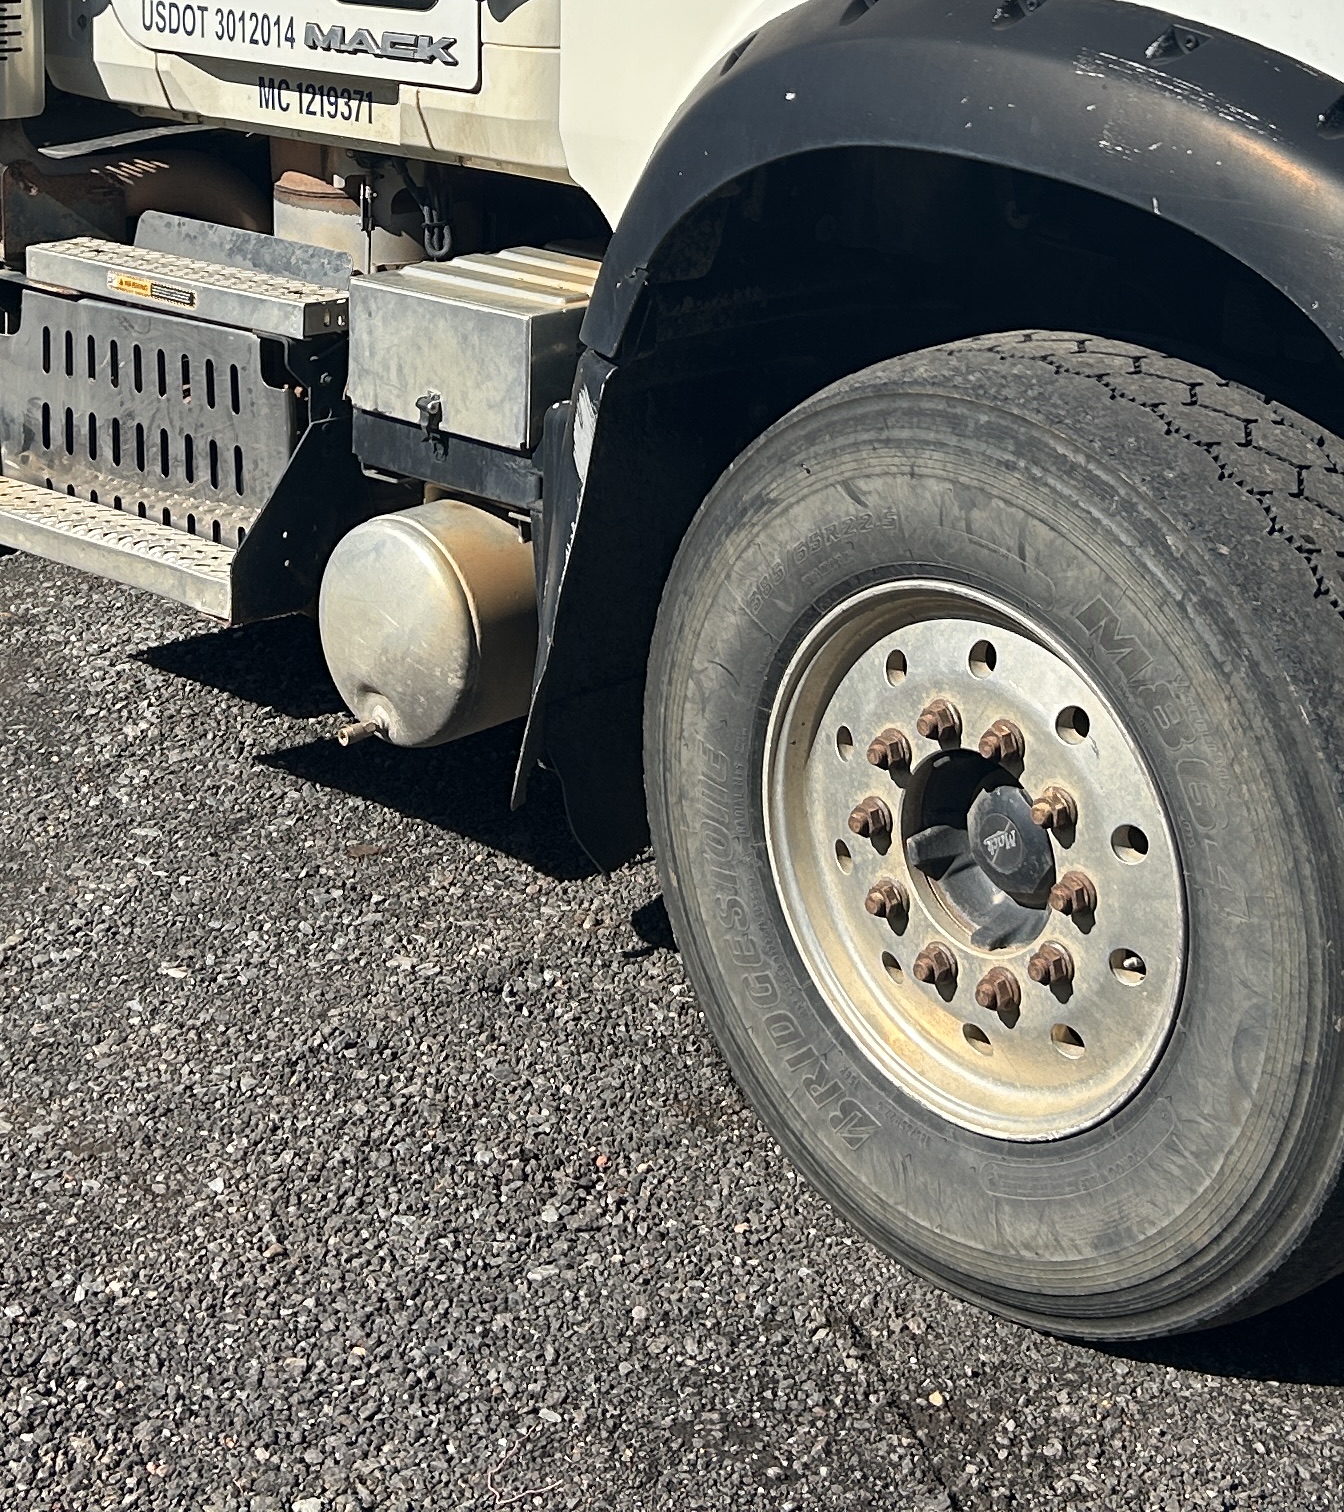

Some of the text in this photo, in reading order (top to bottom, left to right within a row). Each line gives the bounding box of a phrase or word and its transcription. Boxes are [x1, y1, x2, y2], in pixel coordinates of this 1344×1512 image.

[215, 8, 296, 49] 3012014
[304, 22, 459, 66] MACK
[258, 76, 374, 124] MC 1219371
[1075, 596, 1251, 922] M864
[700, 736, 882, 1152] BRIDGESTONE
